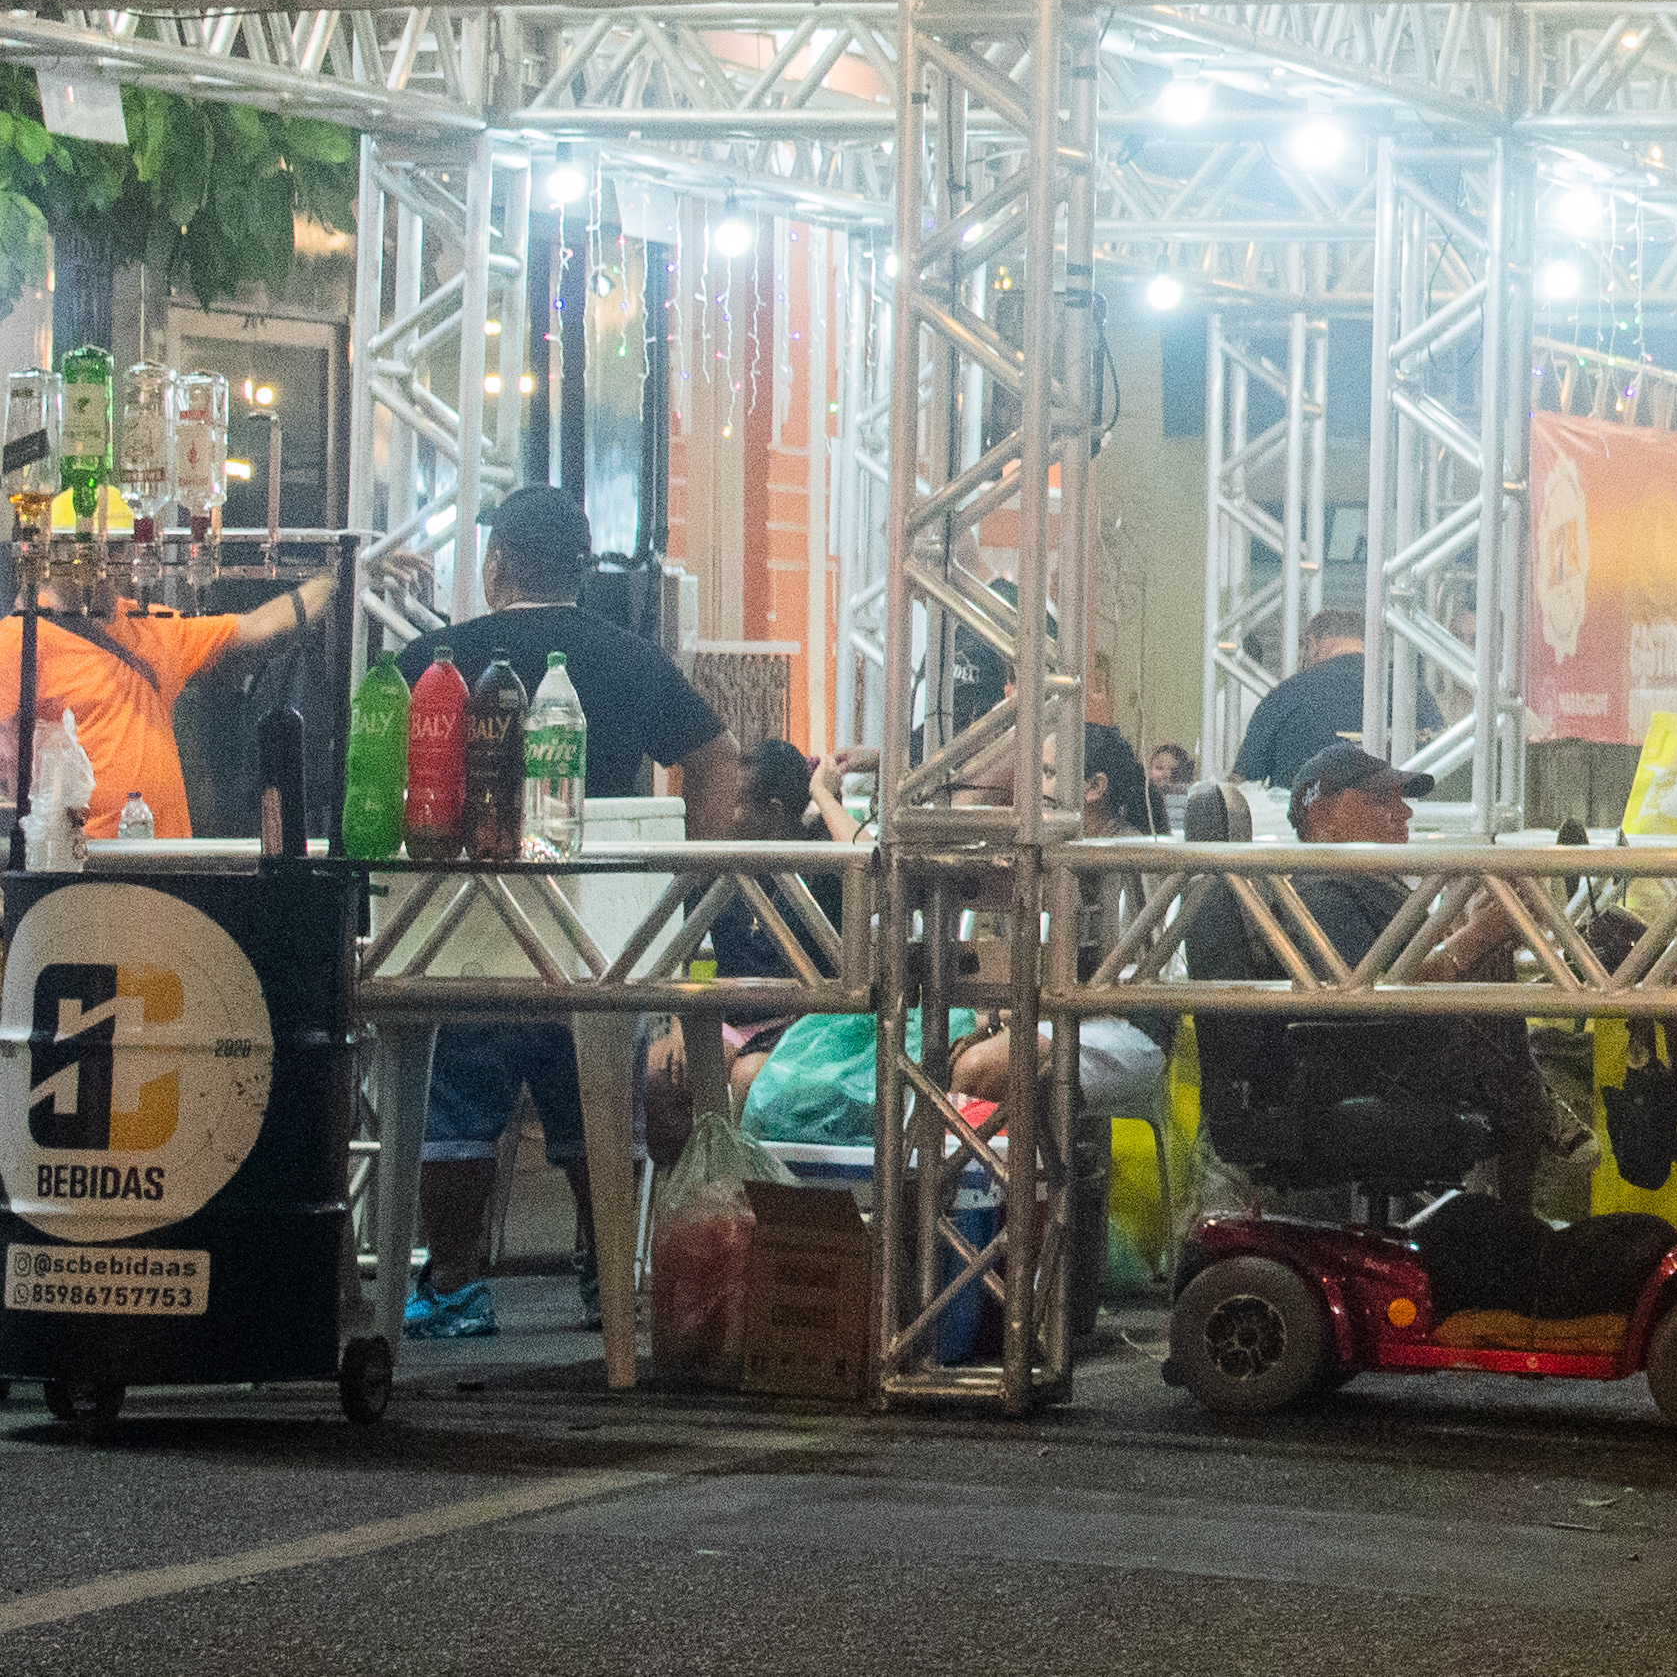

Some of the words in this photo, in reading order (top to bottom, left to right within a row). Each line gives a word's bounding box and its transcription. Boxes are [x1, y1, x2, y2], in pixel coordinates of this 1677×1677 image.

[411, 712, 456, 740] BALY
[37, 1165, 164, 1200] BEBIDAS
[34, 1252, 197, 1277] @scbebidaas
[32, 1284, 192, 1307] 85986757753
